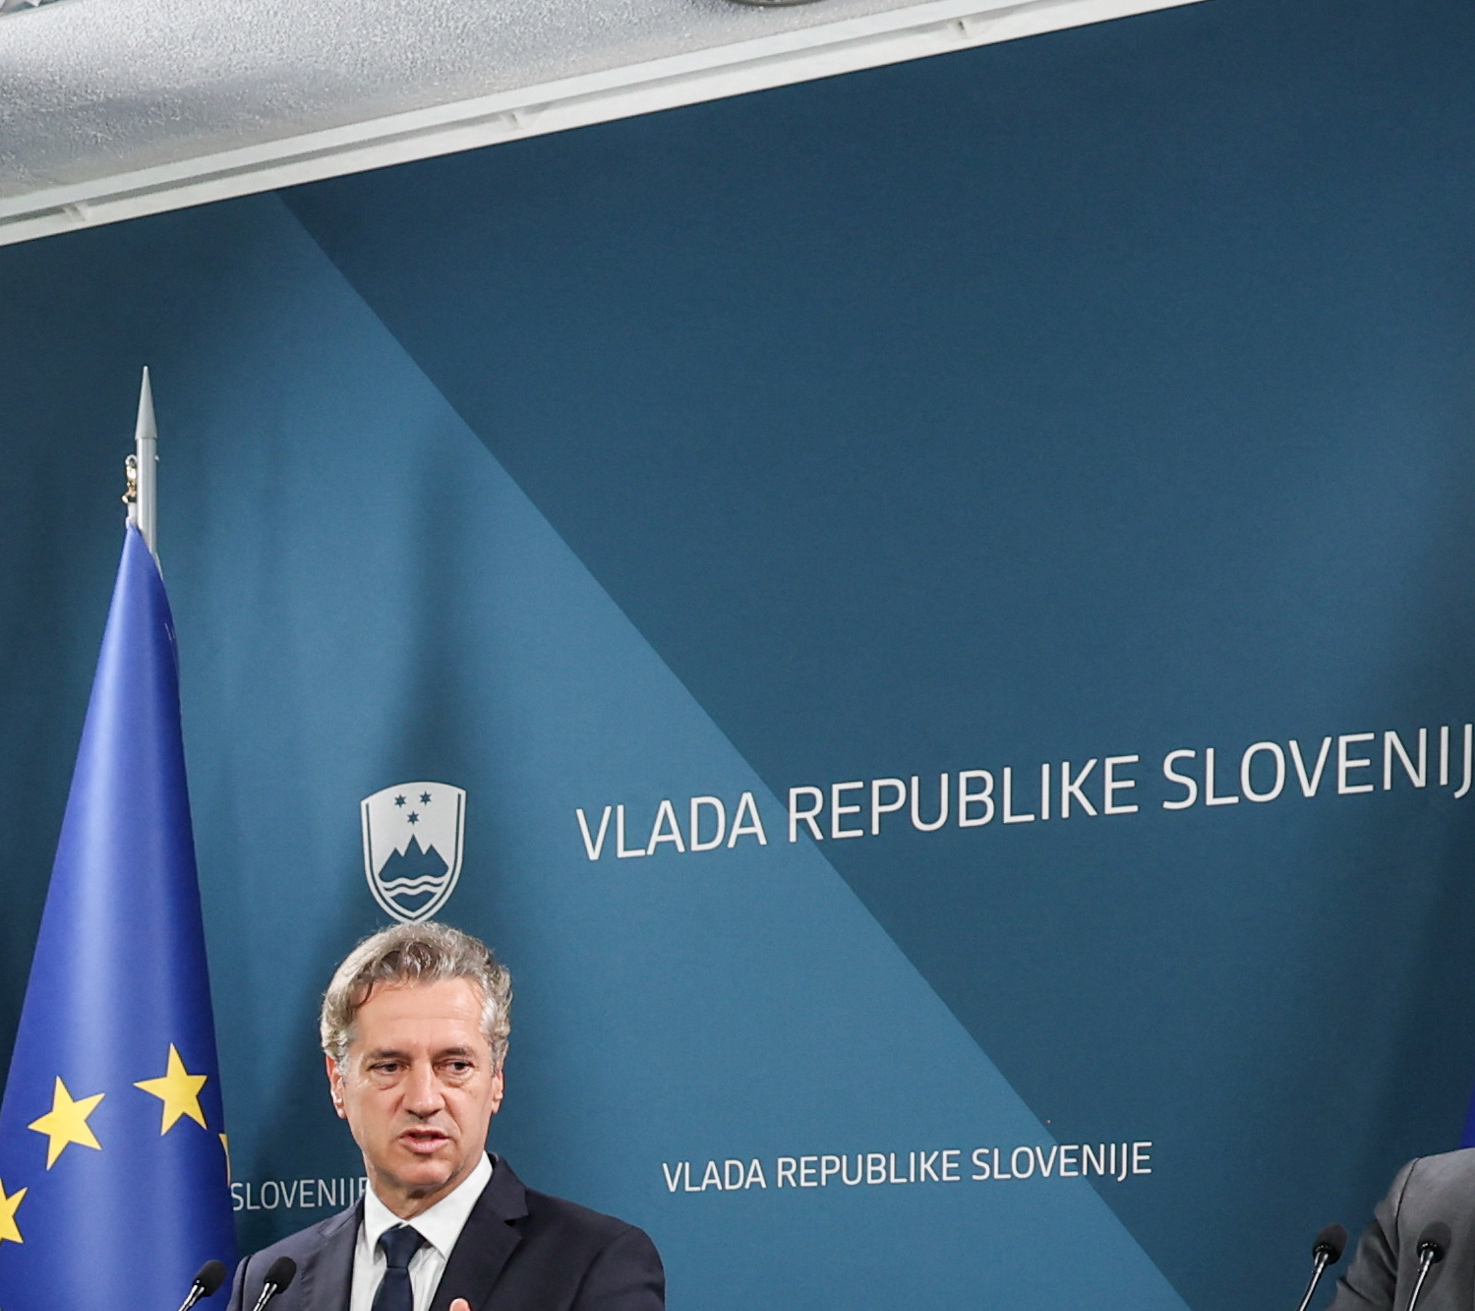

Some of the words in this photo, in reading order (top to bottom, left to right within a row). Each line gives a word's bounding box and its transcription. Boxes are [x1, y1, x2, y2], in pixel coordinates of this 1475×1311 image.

[575, 791, 768, 861] VLADA
[788, 753, 1140, 843] REPUBLIKE
[662, 1158, 767, 1193] VLADA
[777, 1149, 961, 1188] REPUBLIKE
[971, 1141, 1153, 1182] SLOVENIJE
